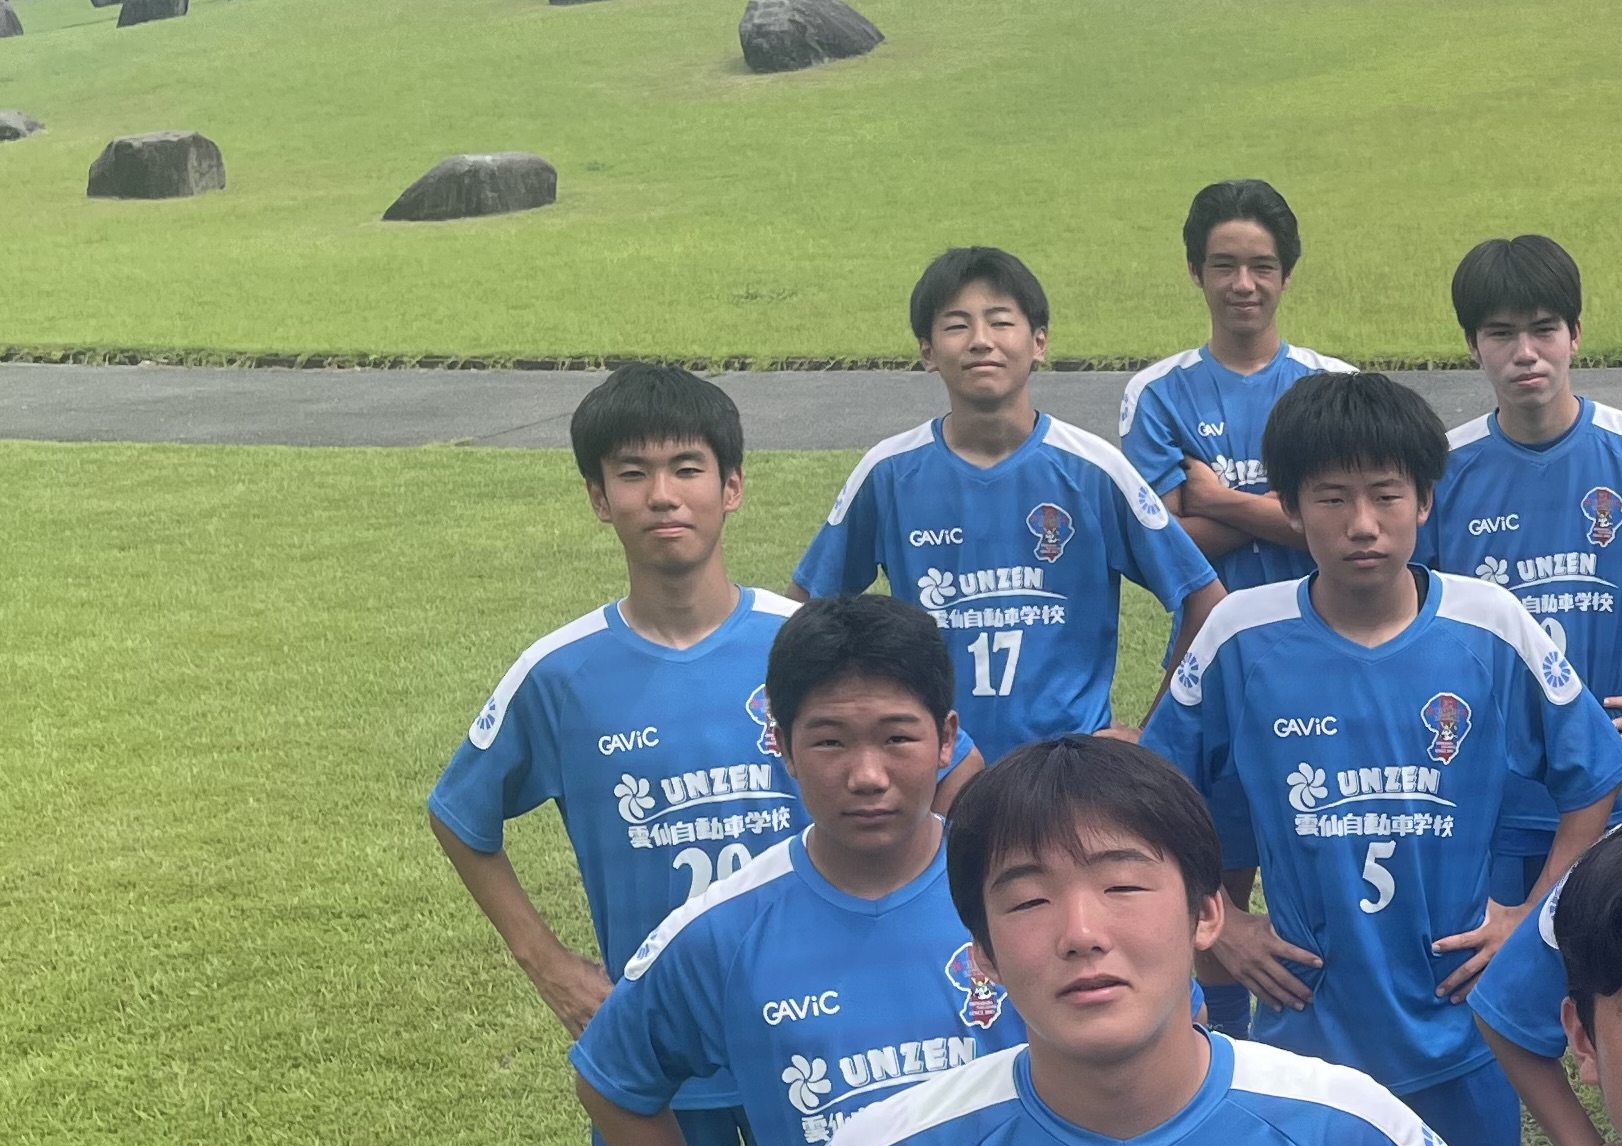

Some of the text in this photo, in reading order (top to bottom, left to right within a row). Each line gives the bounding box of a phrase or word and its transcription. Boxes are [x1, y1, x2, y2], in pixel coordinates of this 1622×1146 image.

[909, 528, 963, 547] GAViC
[1468, 514, 1520, 536] GAViC
[958, 566, 1043, 596] UNZEN
[1516, 552, 1597, 582] UNZEN
[967, 630, 1023, 696] 17
[599, 727, 659, 755] GAViC
[1273, 716, 1338, 737] GAViC
[660, 764, 771, 805] UNZEN
[1337, 766, 1441, 797] UNZEN
[628, 806, 790, 848] 雲仙自動車学校
[1294, 813, 1454, 838] 雲仙自動車学校
[1359, 840, 1397, 914] 5
[763, 990, 840, 1025] GAViC
[839, 1037, 976, 1087] UNZEN
